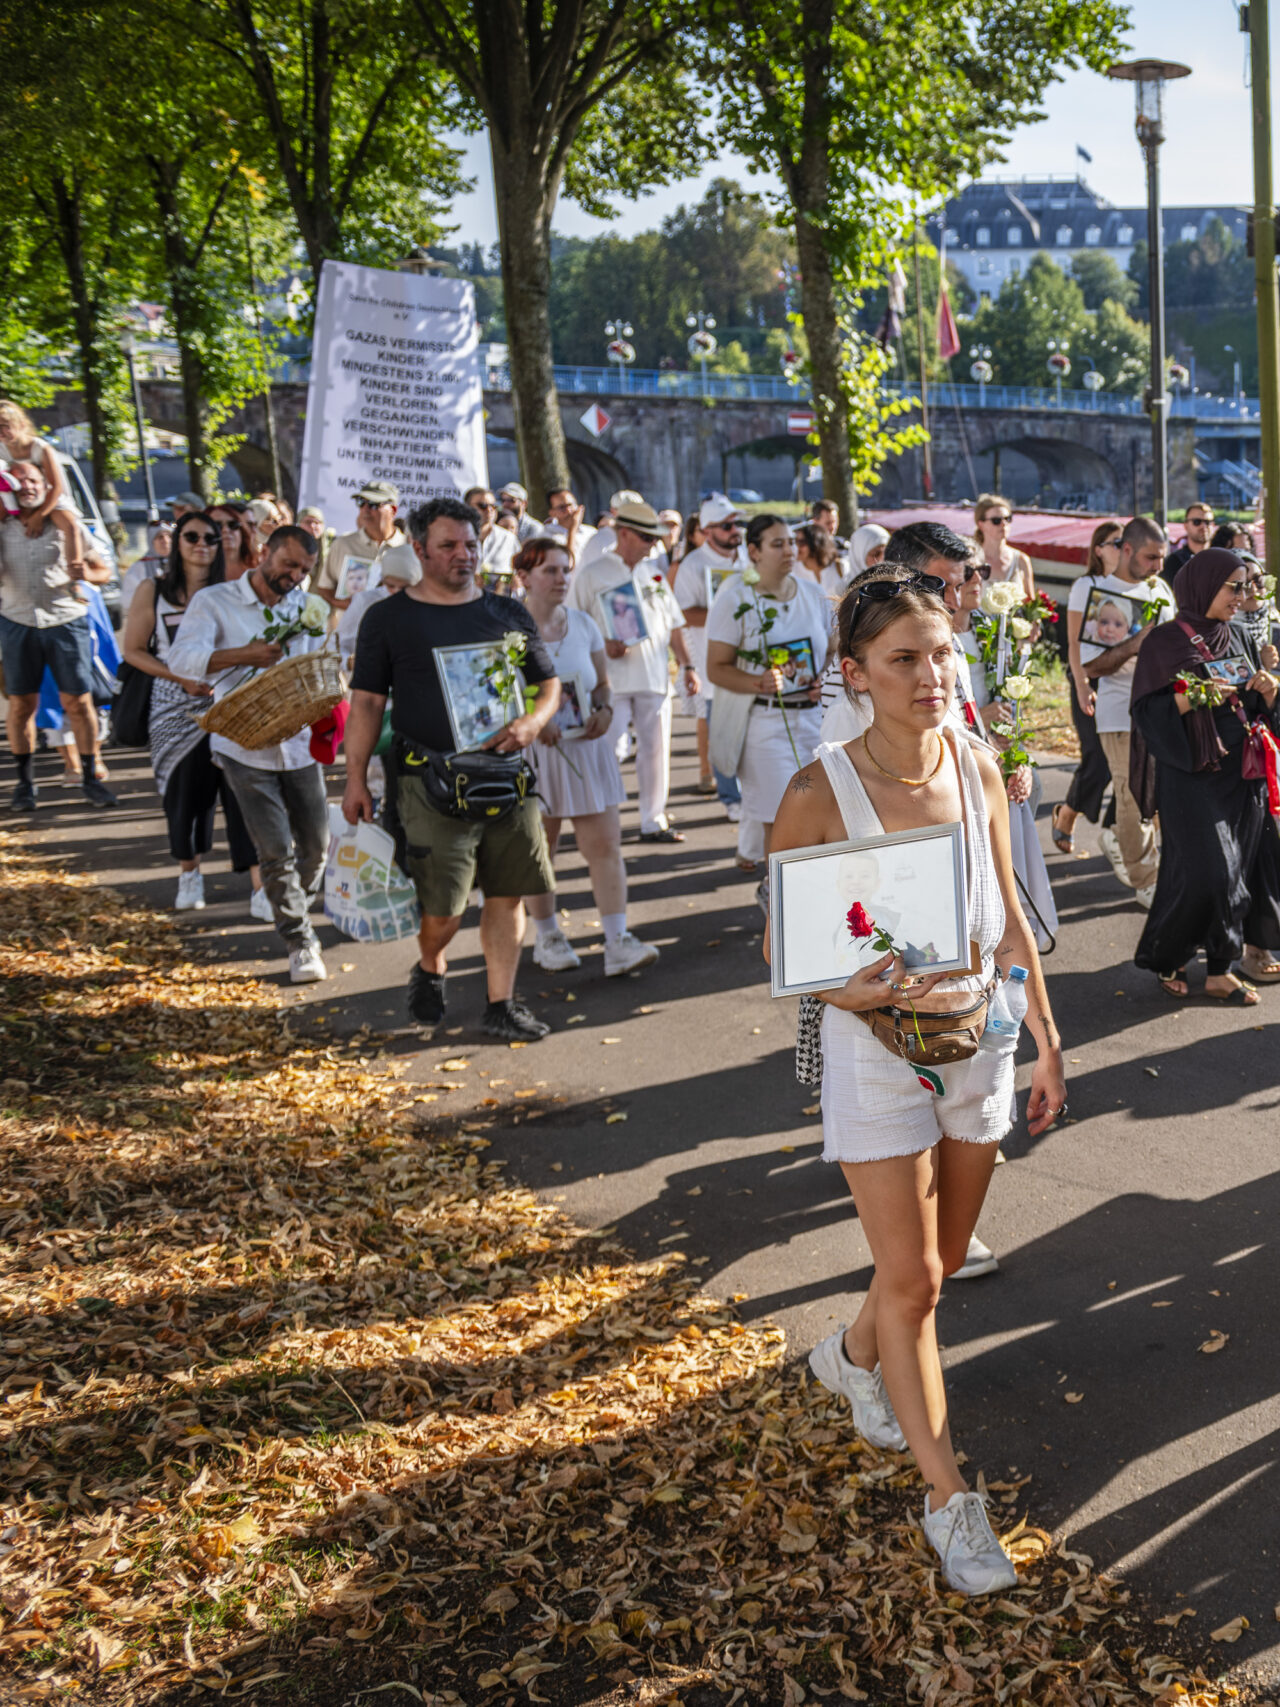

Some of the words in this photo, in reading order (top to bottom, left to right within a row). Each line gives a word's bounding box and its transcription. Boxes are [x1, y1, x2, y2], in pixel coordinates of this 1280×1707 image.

[345, 328, 388, 346] GAZAS
[341, 359, 423, 381] MINDESTENS
[359, 377, 410, 394] KINDER
[413, 384, 444, 397] SIND
[364, 393, 439, 411] VERLOREN
[360, 406, 441, 428] GEGANGEN,
[342, 419, 458, 442] VERSCHWUNDEN,
[337, 447, 383, 465] UNTER
[387, 452, 465, 471] TRÜMMERN
[371, 466, 413, 481] ODER
[415, 471, 430, 483] IN
[336, 476, 461, 498] MASGRÄBERN
